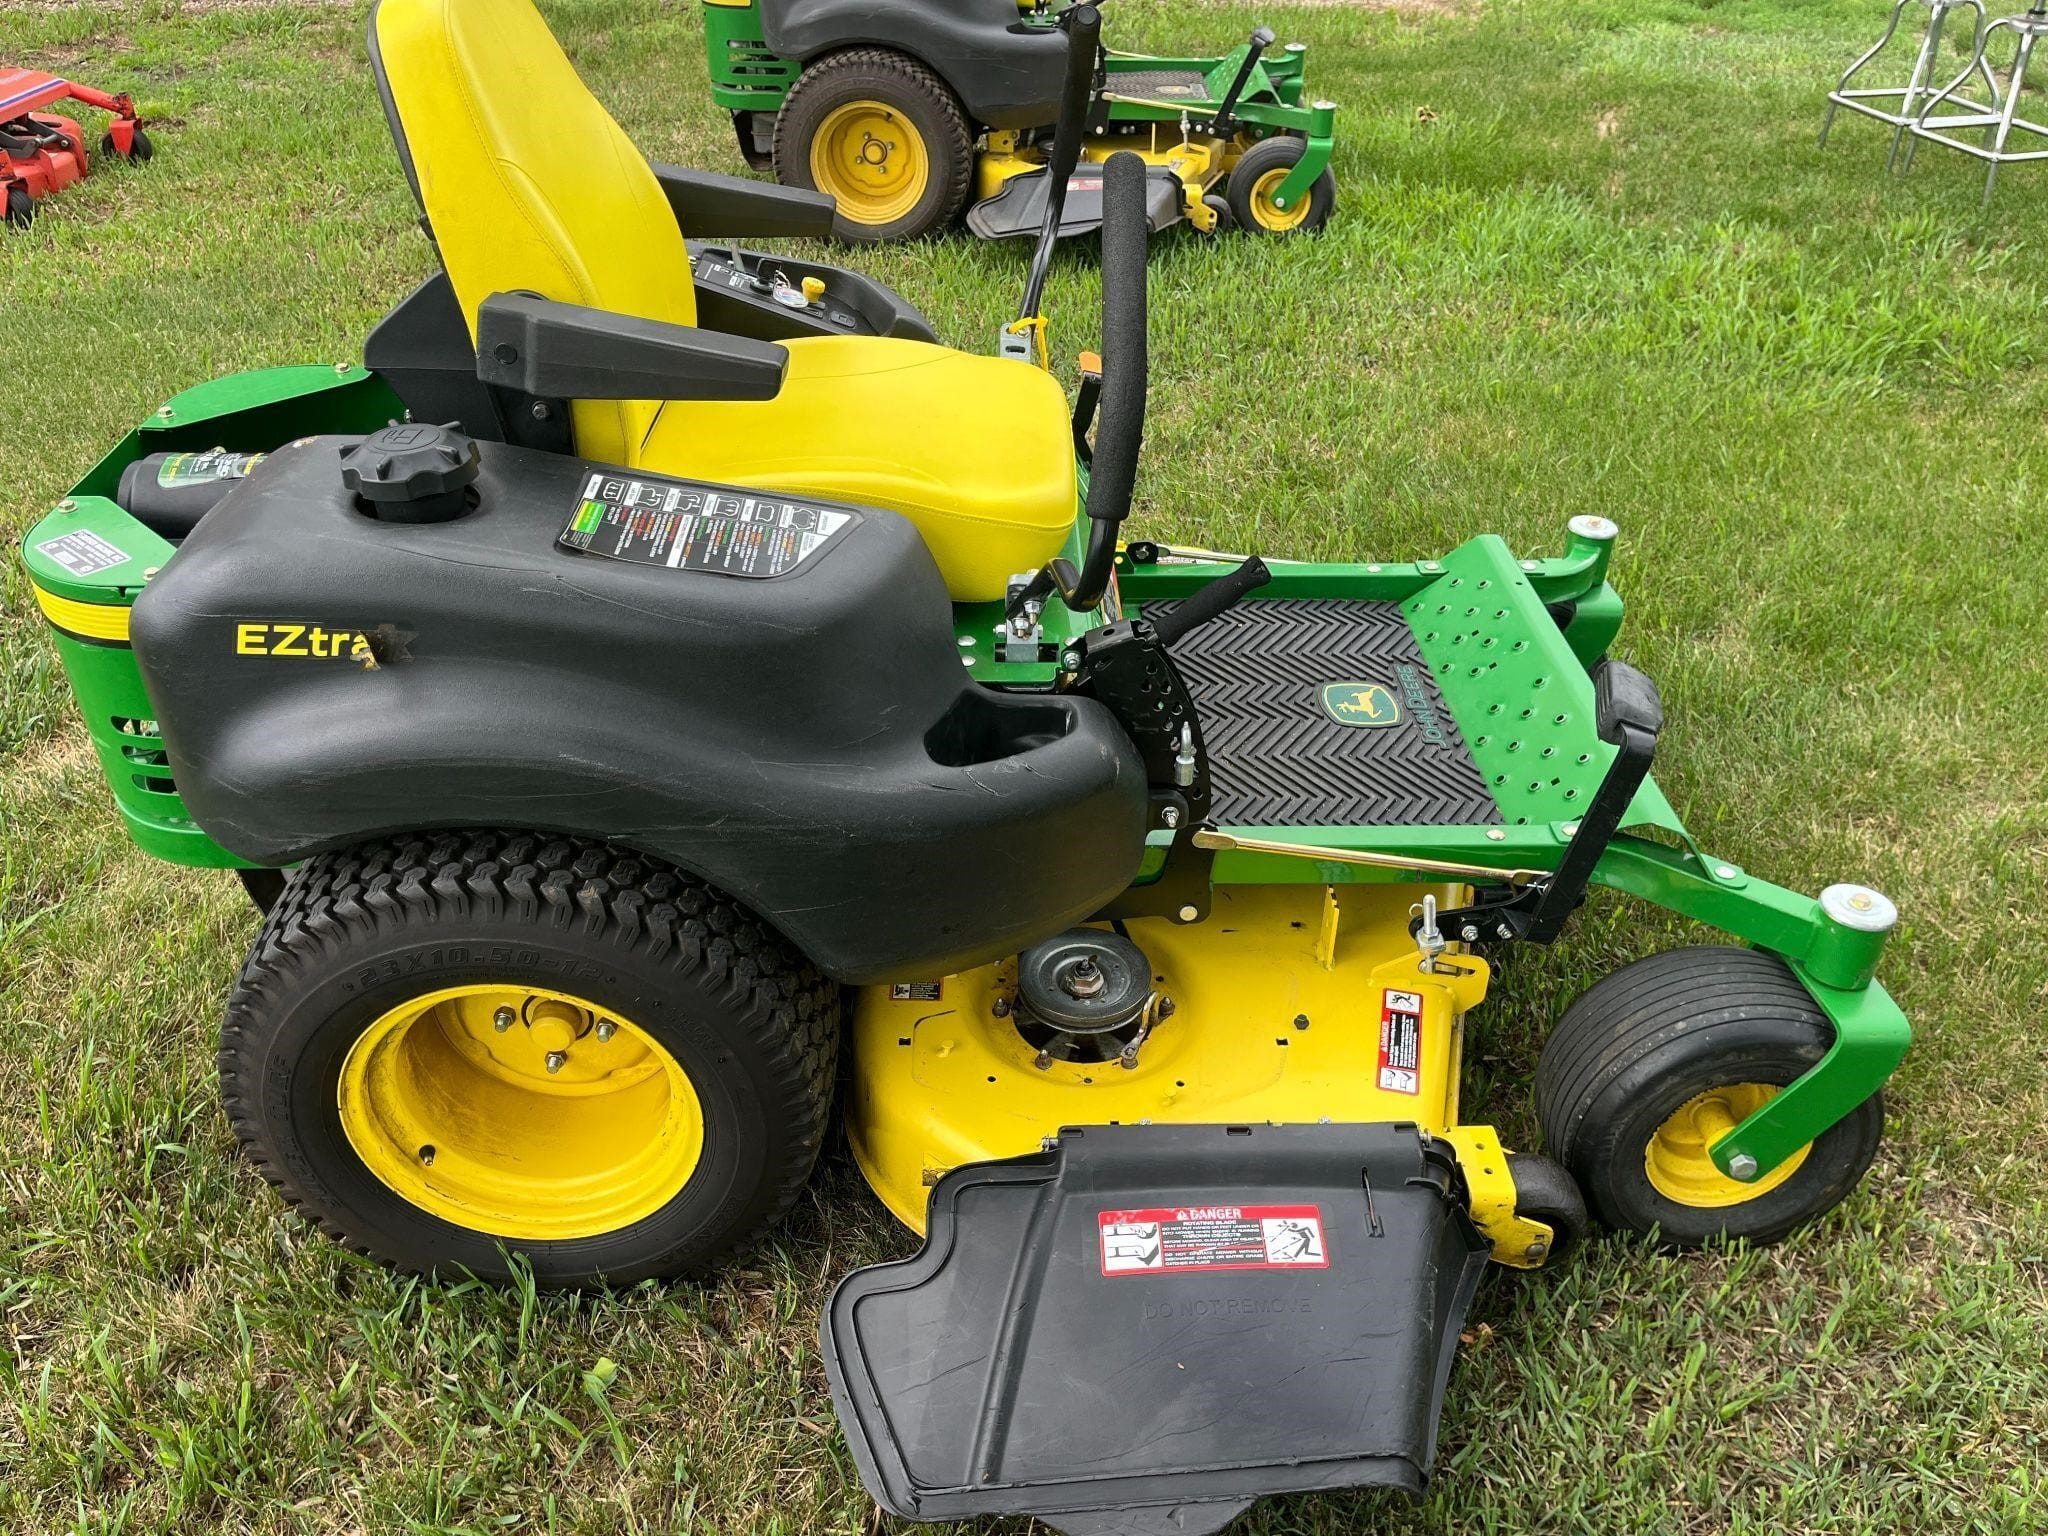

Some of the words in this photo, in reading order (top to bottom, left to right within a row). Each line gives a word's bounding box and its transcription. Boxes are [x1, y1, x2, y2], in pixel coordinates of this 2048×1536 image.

[1396, 664, 1428, 708] DEERE
[1415, 709, 1448, 749] JOHN
[1189, 1208, 1242, 1220] DANGER
[1145, 1302, 1174, 1320] DO
[1179, 1300, 1220, 1317] NOT
[1226, 1298, 1313, 1315] REMOVE
